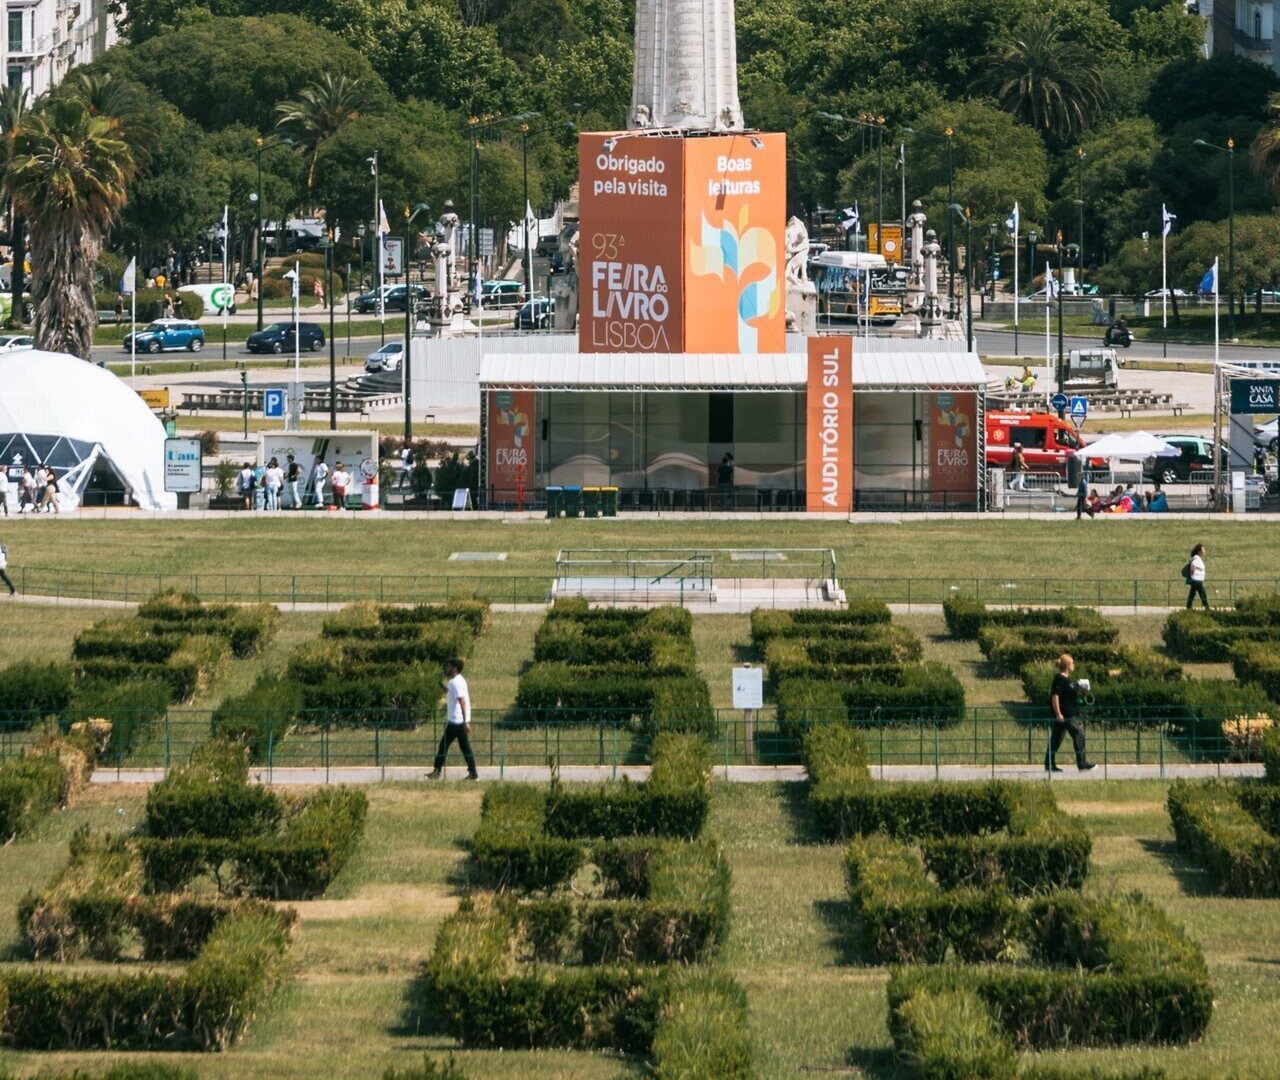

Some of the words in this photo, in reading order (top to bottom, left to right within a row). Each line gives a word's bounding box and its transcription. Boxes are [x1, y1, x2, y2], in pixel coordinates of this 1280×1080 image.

[596, 154, 665, 175] Obrigado
[717, 156, 752, 172] Boas
[594, 178, 626, 196] pela
[628, 178, 668, 197] visita
[708, 179, 761, 196] leituras
[592, 261, 666, 293] FEIRA
[592, 291, 669, 322] LIVRO
[592, 321, 670, 351] LISBOA
[823, 347, 840, 386] SUL
[1249, 394, 1274, 404] CASA
[1250, 385, 1274, 394] SANTA
[268, 394, 280, 413] P
[496, 448, 527, 457] FEIRA
[819, 391, 840, 507] AUDITÓRIO
[937, 449, 968, 458] FEIRA
